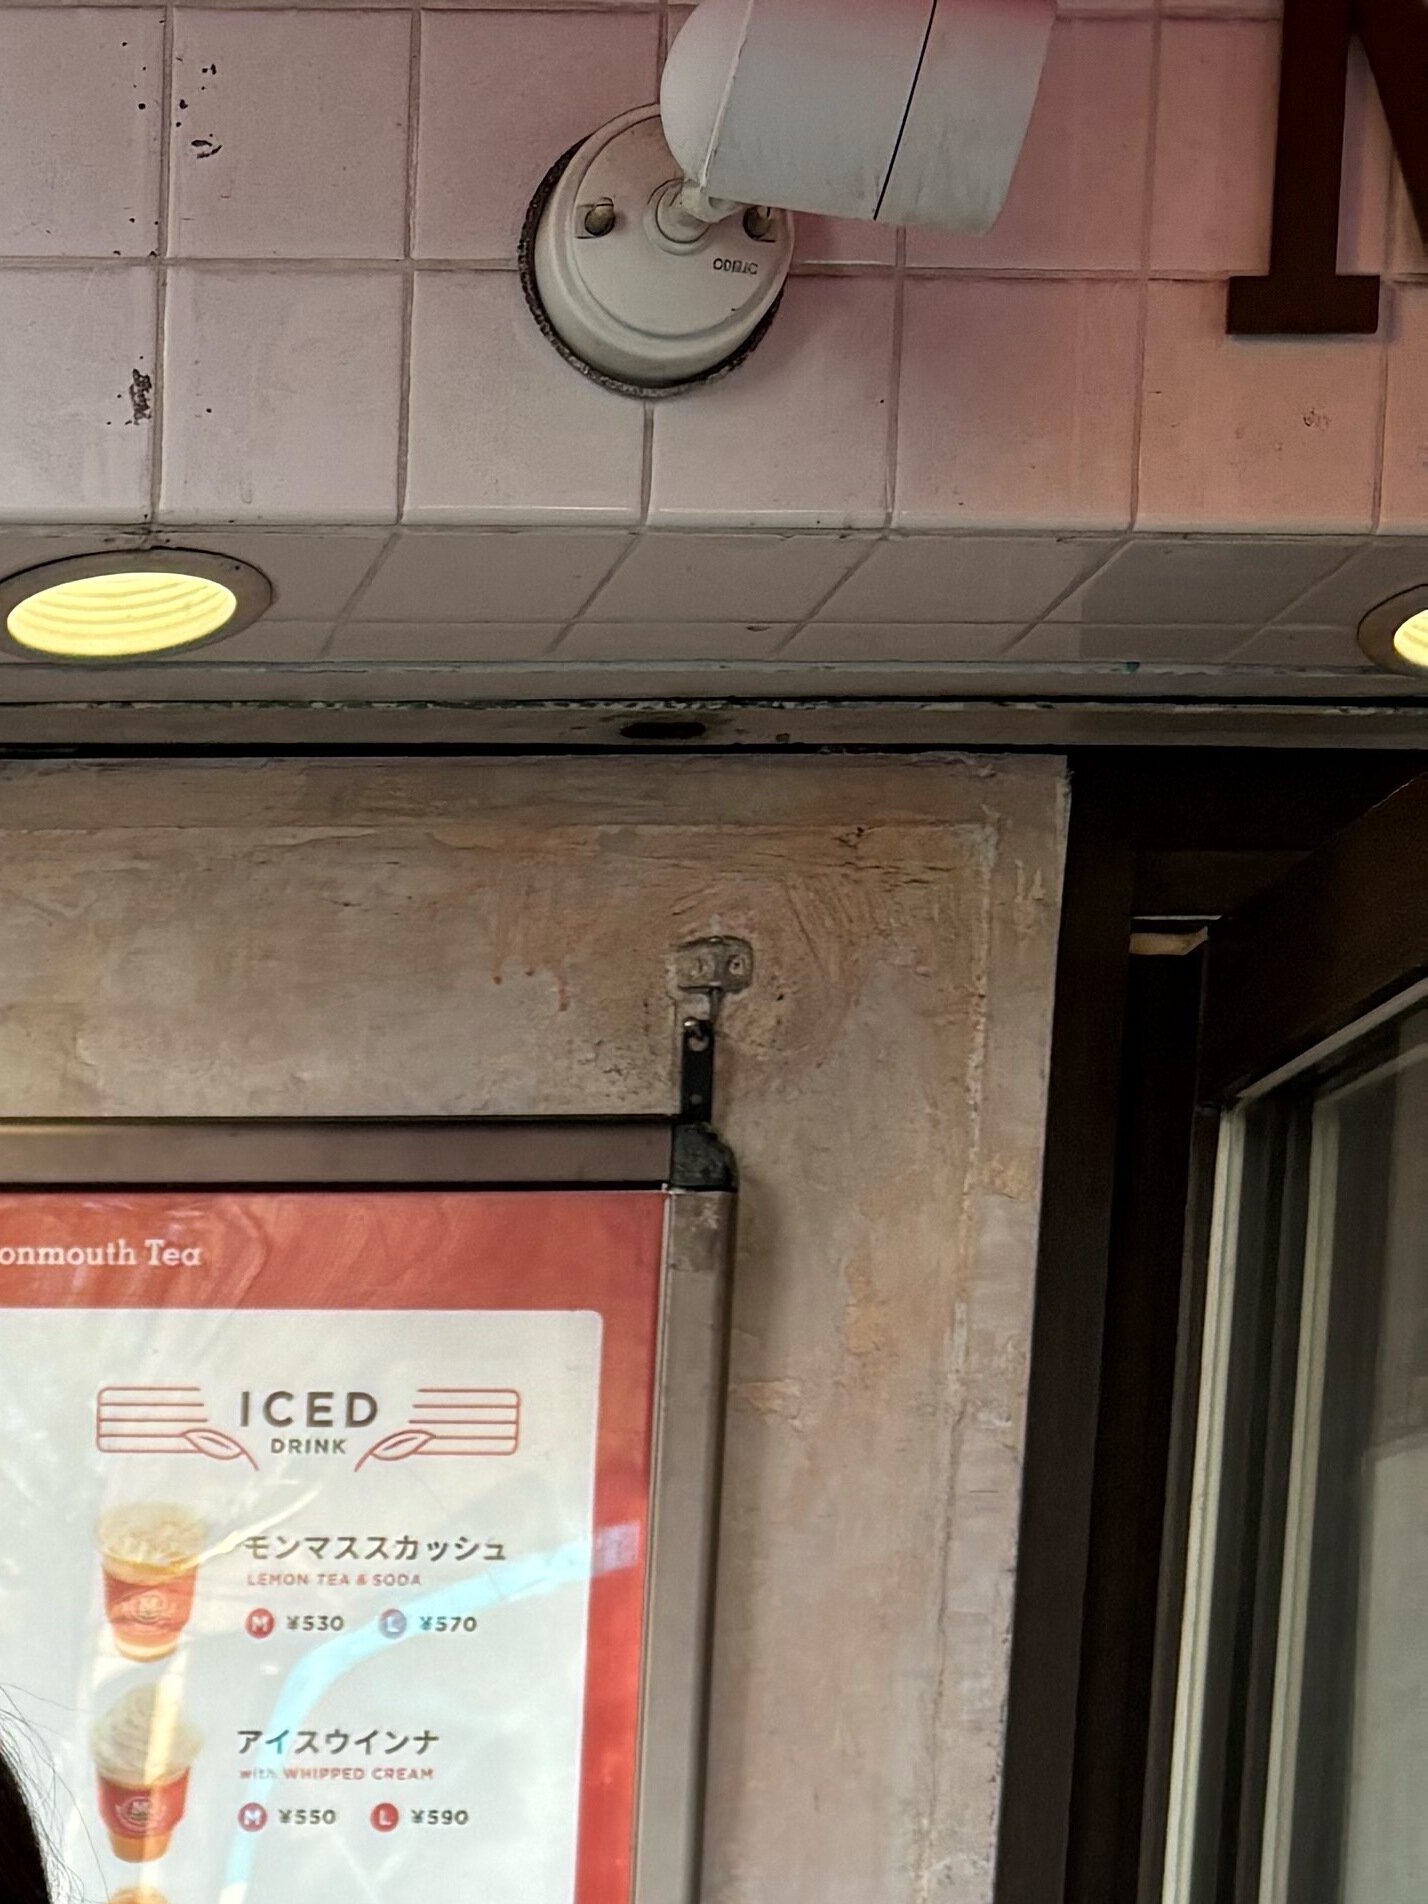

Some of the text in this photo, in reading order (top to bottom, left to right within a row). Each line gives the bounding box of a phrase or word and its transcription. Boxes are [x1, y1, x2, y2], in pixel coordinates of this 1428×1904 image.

[144, 1238, 201, 1266] Tea
[240, 1389, 380, 1428] ICED
[270, 1438, 349, 1455] DRINK
[244, 1533, 508, 1563] モンマススカッシュ
[246, 1573, 310, 1587] LEMON
[316, 1573, 350, 1587] TEA
[371, 1573, 423, 1587] SODA
[285, 1615, 345, 1633] ¥530
[418, 1615, 478, 1633] ¥570
[283, 1767, 366, 1781] WHIPPED
[371, 1767, 435, 1781] CREAM
[277, 1808, 337, 1826] ¥550
[410, 1808, 470, 1826] ¥590
